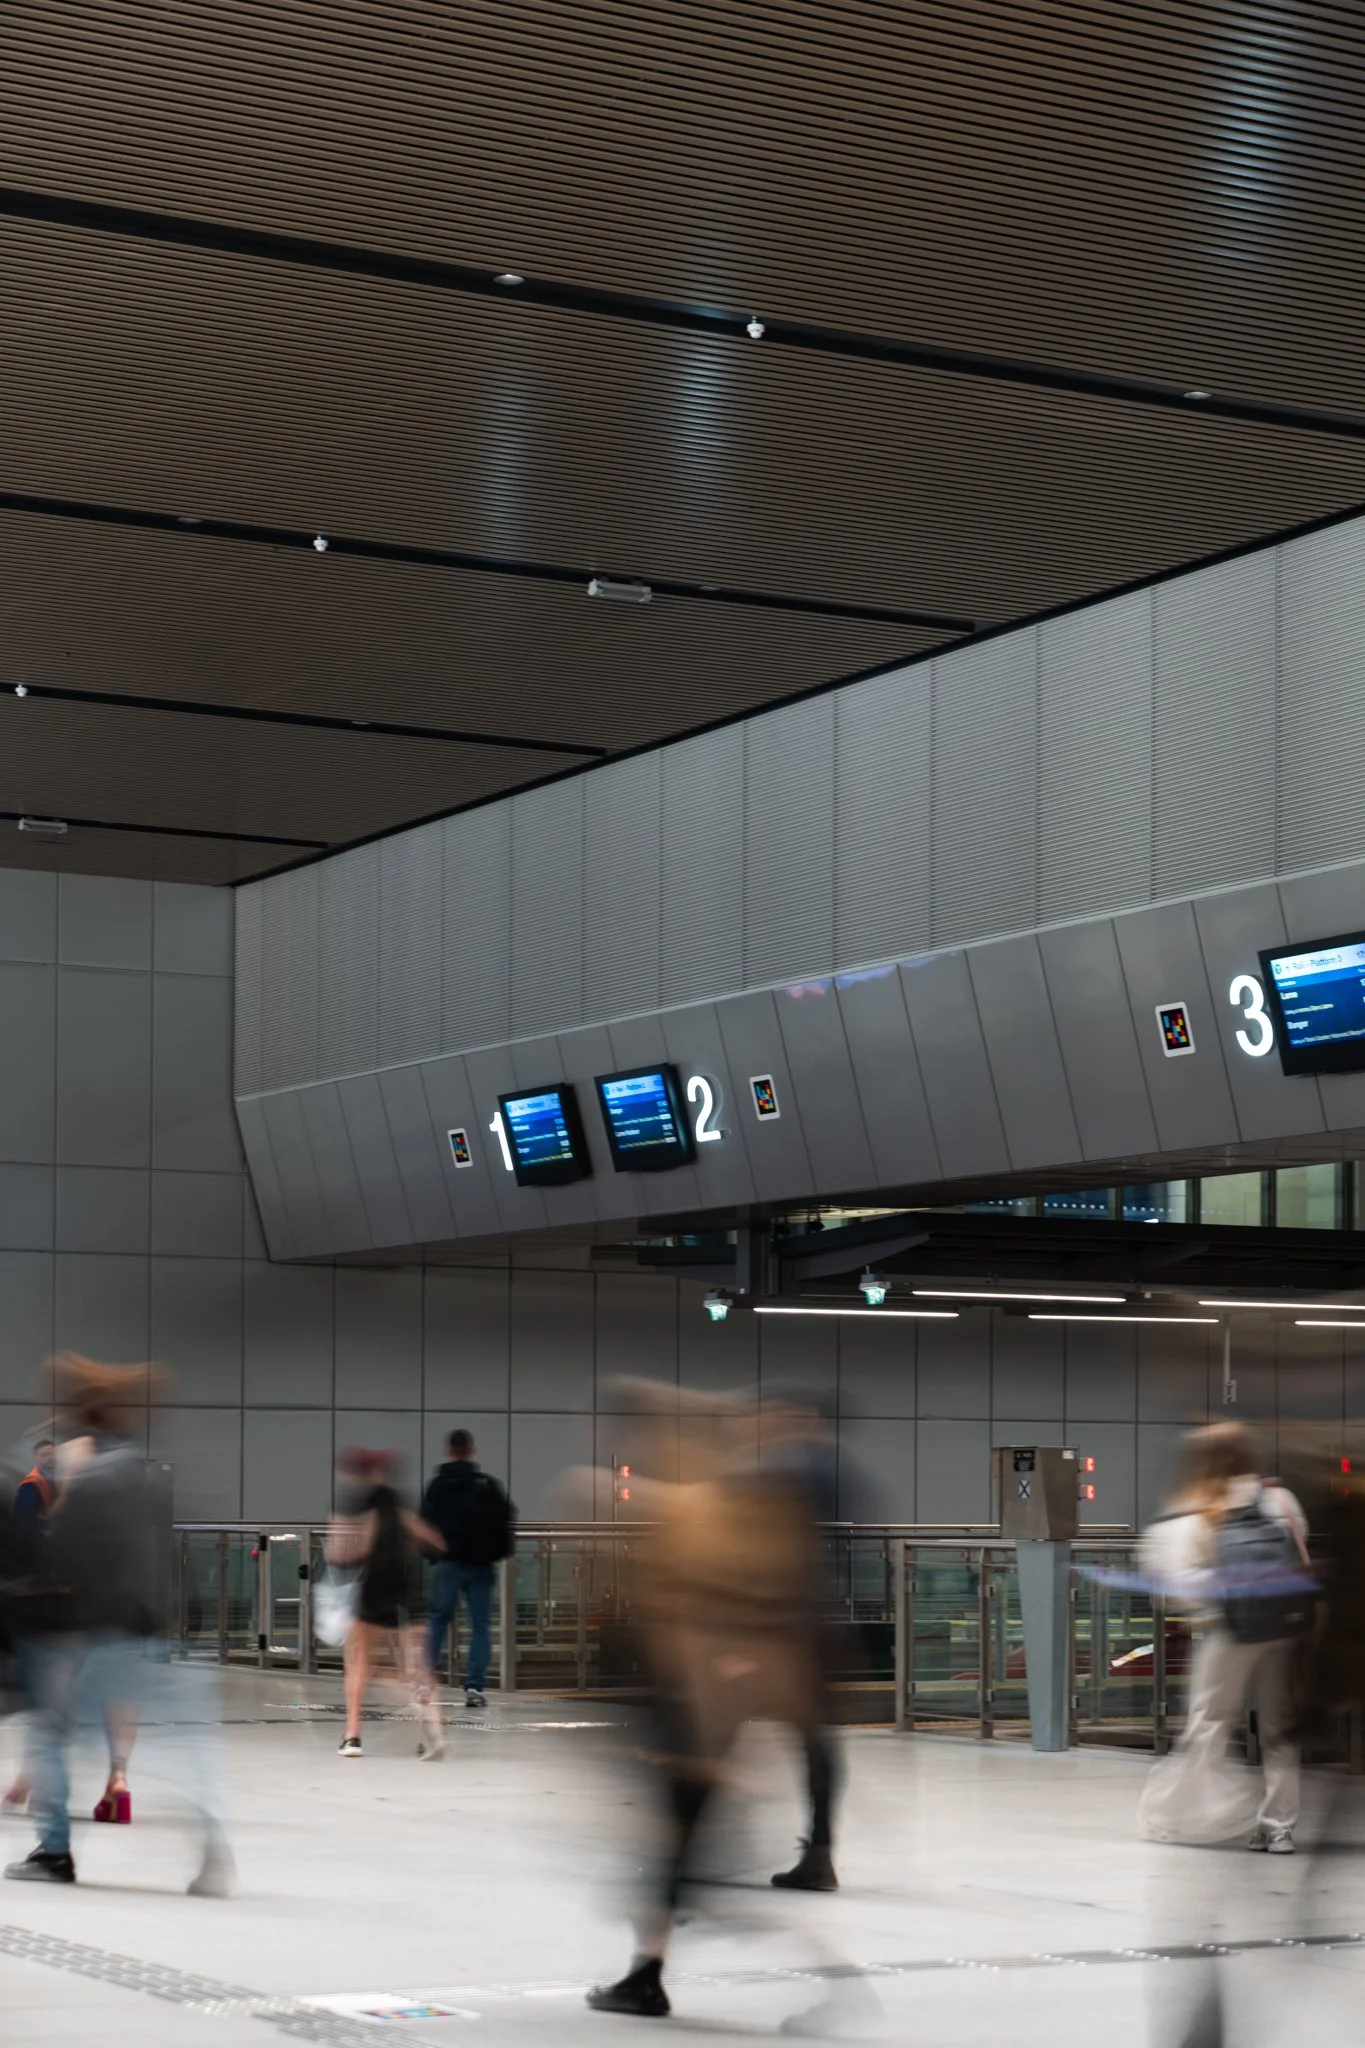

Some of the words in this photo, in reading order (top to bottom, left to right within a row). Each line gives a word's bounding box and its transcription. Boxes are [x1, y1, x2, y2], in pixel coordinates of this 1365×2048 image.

[1229, 974, 1274, 1057] 3
[488, 1111, 514, 1172] 1
[686, 1075, 722, 1143] 2
